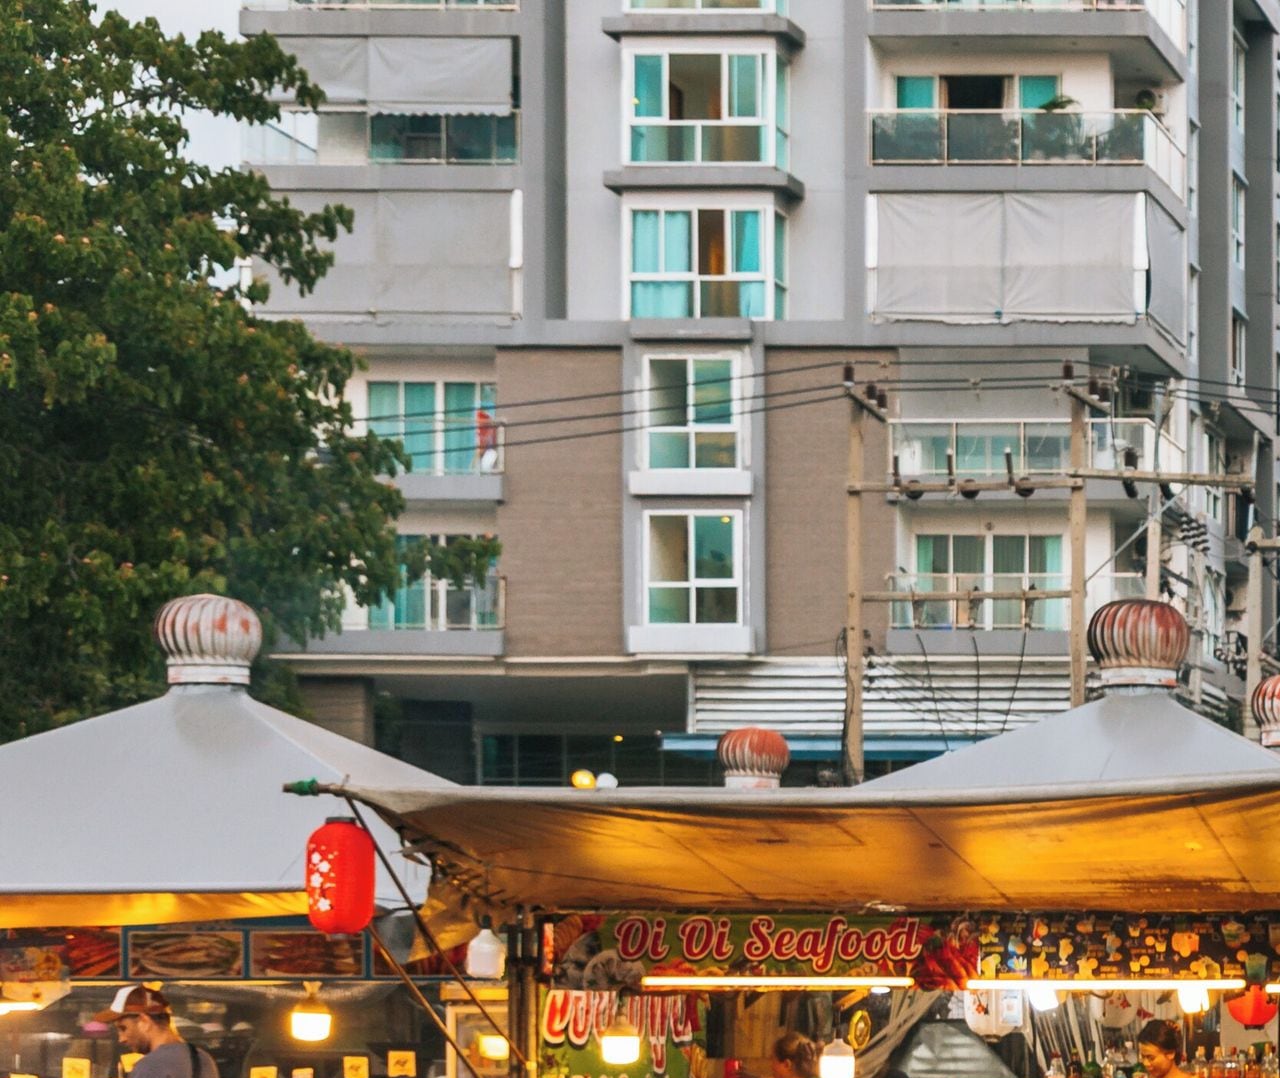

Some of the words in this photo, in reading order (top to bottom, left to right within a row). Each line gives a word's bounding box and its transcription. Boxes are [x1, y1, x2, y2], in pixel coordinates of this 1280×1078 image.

[615, 916, 669, 961] Oi
[679, 916, 733, 961] Oi
[745, 916, 923, 974] Seafood
